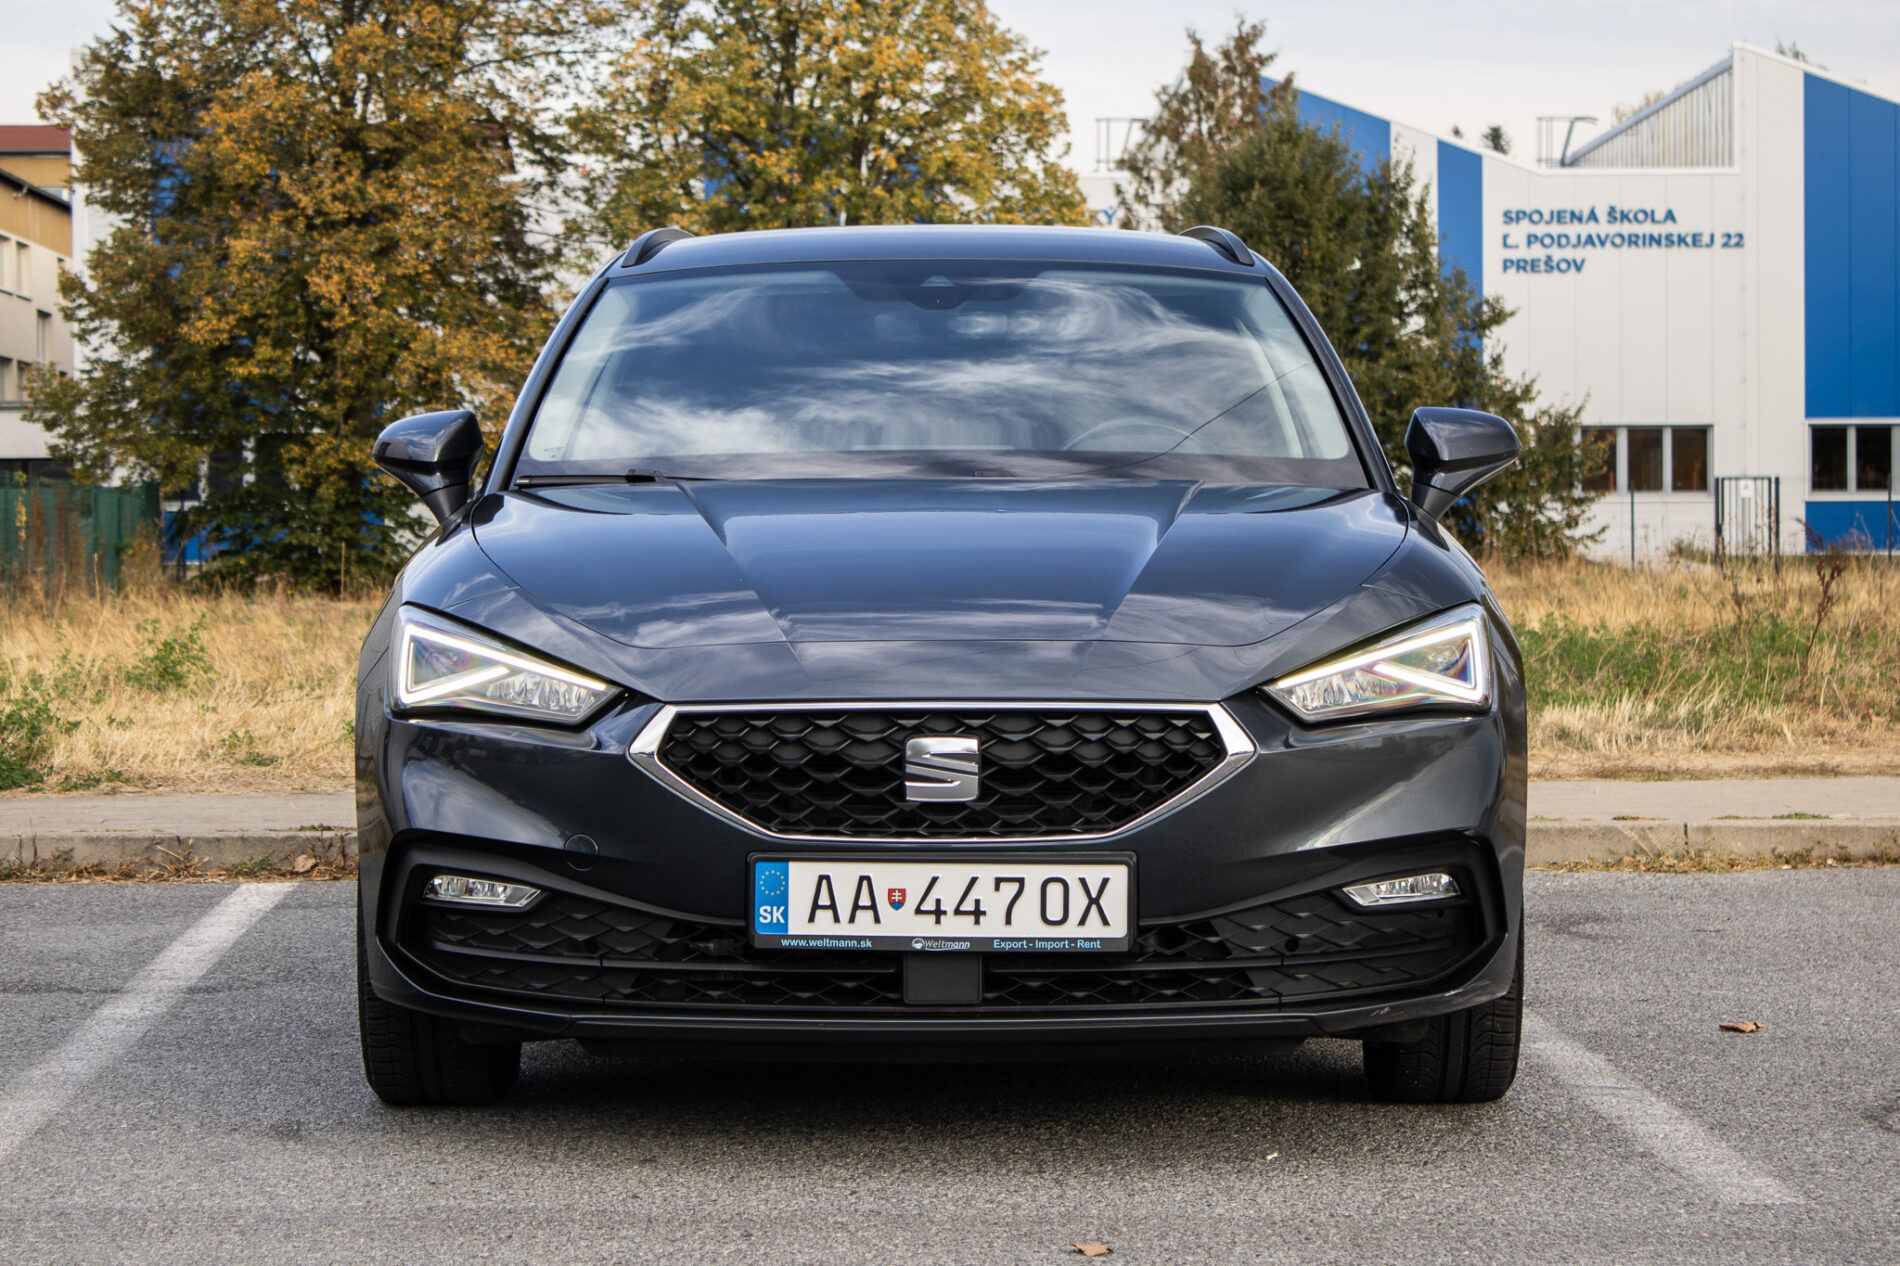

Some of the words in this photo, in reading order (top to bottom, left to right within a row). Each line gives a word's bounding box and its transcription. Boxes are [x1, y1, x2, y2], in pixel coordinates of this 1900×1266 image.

[1502, 206, 1599, 225] SPOJENÁ
[1606, 206, 1677, 225] ŠKOLA
[1526, 232, 1715, 249] PODJAVORINSKEJ
[1720, 232, 1745, 249] 22
[1502, 254, 1586, 273] PREŠOV
[807, 873, 881, 924] AA
[758, 904, 785, 924] SK
[781, 938, 873, 948] www.weltmann.sk
[923, 939, 971, 950] Weltmann
[993, 939, 1028, 950] Export
[1035, 939, 1069, 950] Import
[1077, 939, 1101, 949] Rent
